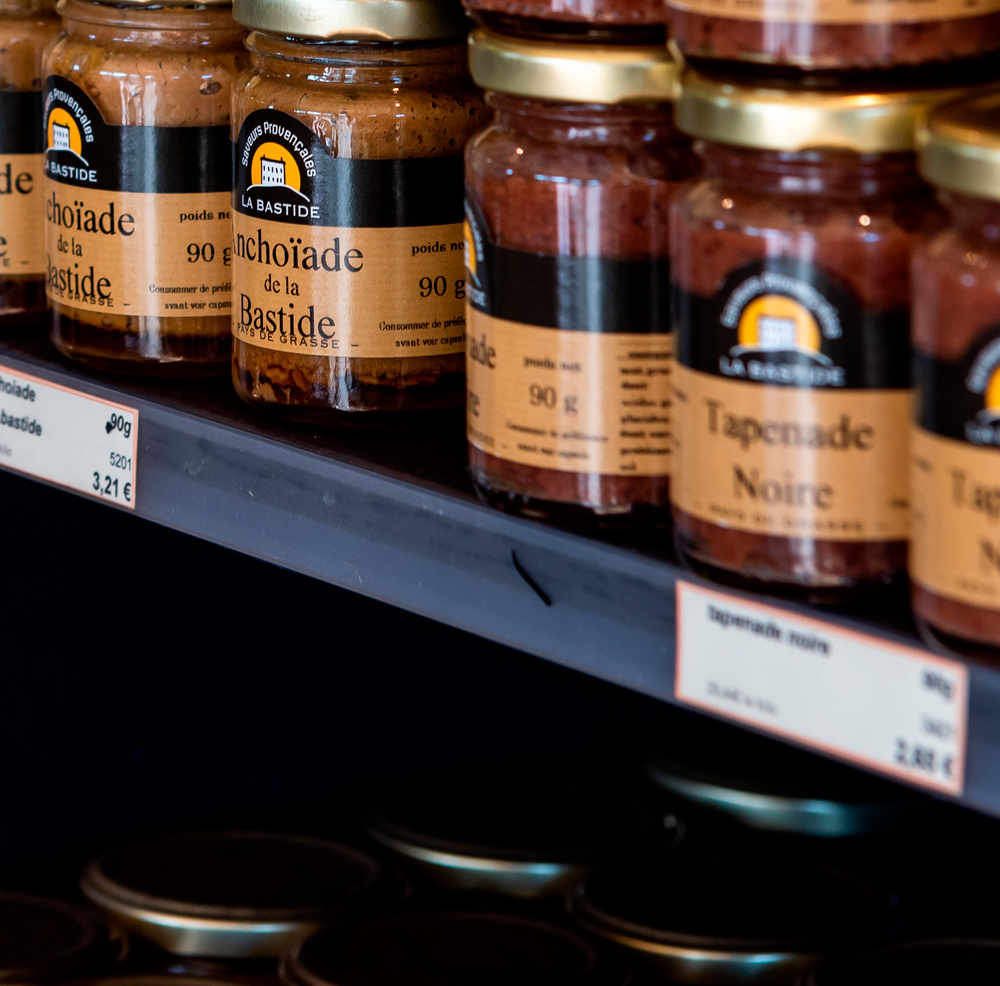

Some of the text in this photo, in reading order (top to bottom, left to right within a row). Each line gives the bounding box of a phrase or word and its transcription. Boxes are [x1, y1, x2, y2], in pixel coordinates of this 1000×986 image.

[264, 121, 316, 177] Provençales
[51, 161, 97, 183] BASTIDE
[46, 191, 135, 237] choïade
[180, 210, 214, 223] poids
[242, 194, 320, 219] LA BASTIDE
[57, 234, 83, 257] de la
[187, 242, 231, 266] 90 g
[411, 241, 464, 256] poids ne
[149, 284, 209, 293] Consommer de
[264, 273, 300, 296] de la
[419, 275, 465, 299] 90 g
[164, 300, 206, 309] avant voir
[240, 293, 336, 339] Bastide
[237, 323, 340, 349] PAYS DE GRASSE
[379, 319, 441, 332] Consommer de
[396, 333, 465, 347] avant voir capsul
[528, 383, 557, 410] 90
[0, 408, 42, 436] bastide
[110, 413, 131, 439] 90g
[110, 452, 131, 471] 5201
[93, 471, 131, 501] 3,21 €
